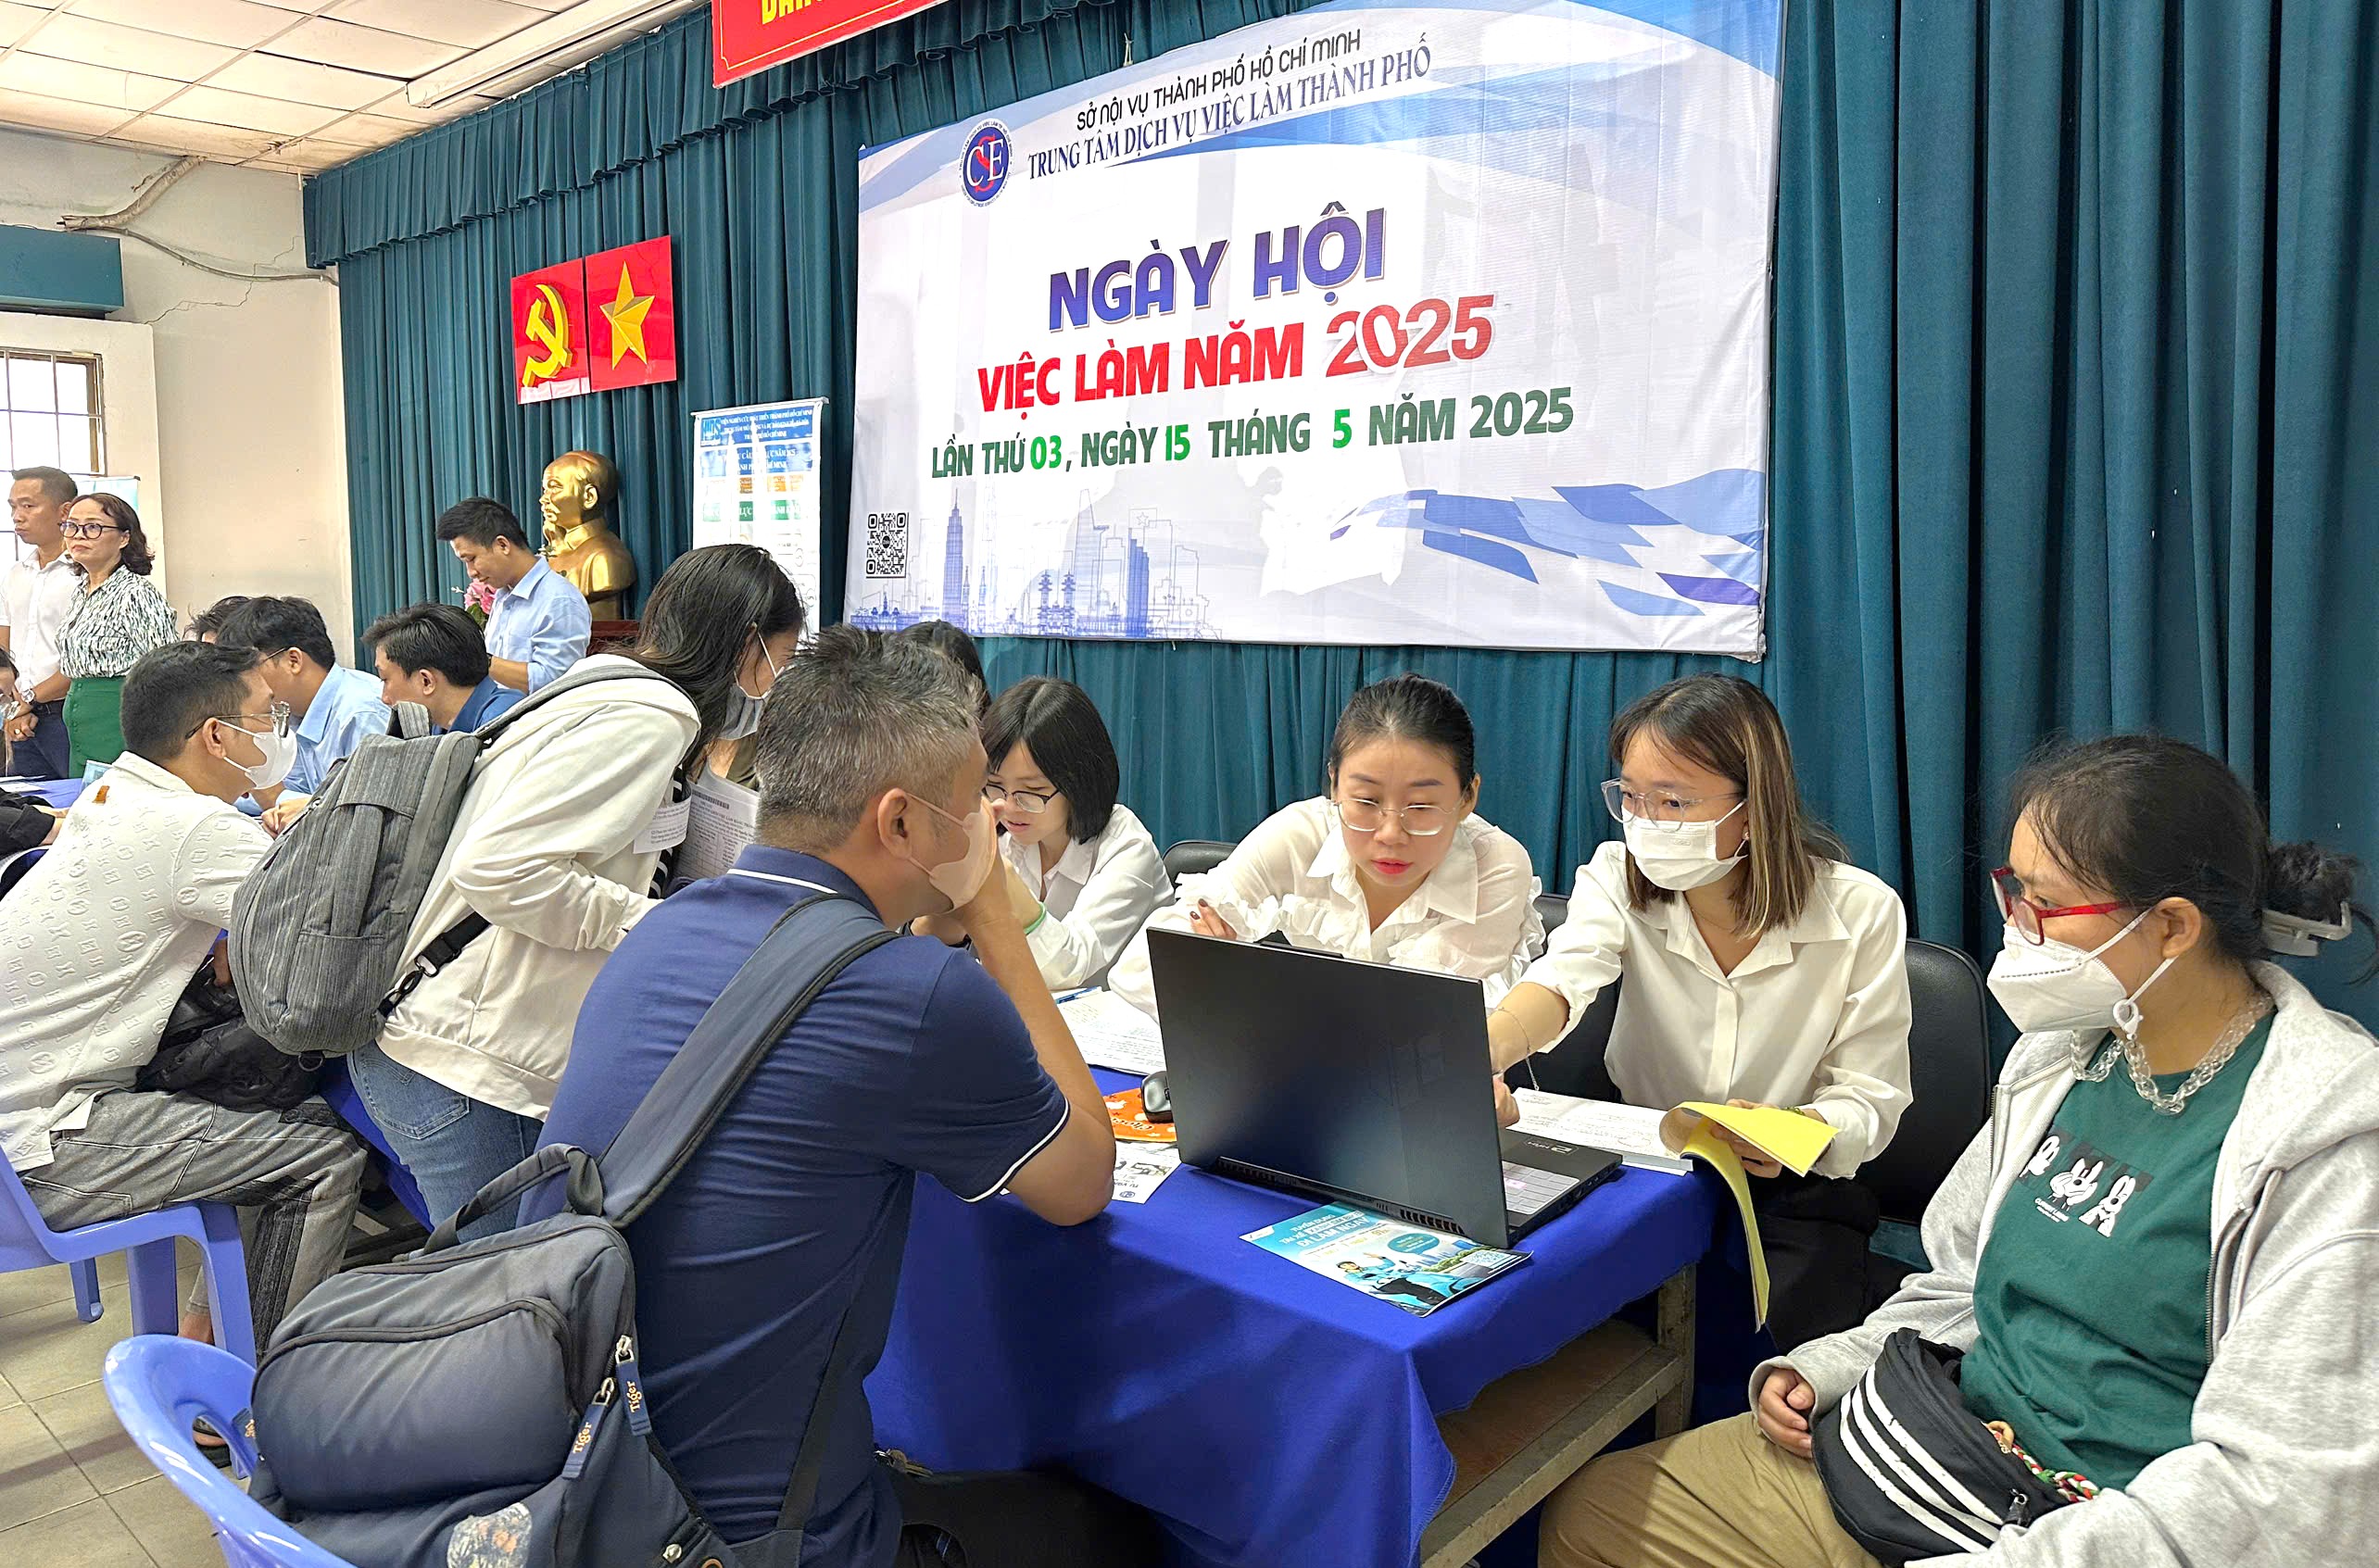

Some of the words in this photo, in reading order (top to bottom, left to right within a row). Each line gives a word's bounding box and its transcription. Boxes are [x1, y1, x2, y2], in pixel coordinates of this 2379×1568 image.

[1027, 142, 1080, 180] TRUNG
[1084, 130, 1120, 165] TÂM
[1125, 117, 1167, 156] DỊCH
[1172, 109, 1197, 143] VỤ
[1202, 93, 1245, 134] VIỆC
[1250, 82, 1292, 121] LÀM
[1297, 59, 1376, 108] THÀNH
[1380, 31, 1431, 87] PHỐ
[1076, 102, 1097, 131] SỞ
[1101, 96, 1122, 125] NỘI
[1127, 93, 1149, 118] VỤ
[1153, 73, 1206, 108] THÀNH
[1212, 53, 1245, 92] PHỐ
[1251, 44, 1273, 81] HỒ
[1279, 37, 1307, 72] CHÍ
[1312, 29, 1361, 63] MINH
[1049, 238, 1229, 333] NGÀY
[1252, 200, 1386, 306] HỘI
[977, 351, 1061, 420] VIỆC
[1075, 339, 1170, 402] LÀM
[1183, 320, 1304, 391] NĂM
[1325, 294, 1496, 379] 2025
[932, 433, 974, 478] LẦN
[981, 432, 1026, 475] THỨ
[1081, 420, 1158, 468] NGÀY
[1164, 423, 1190, 461] 15
[1207, 408, 1311, 458] THÁNG
[1332, 408, 1353, 449] 5
[1368, 392, 1456, 446] NĂM
[1469, 386, 1574, 439] 2025
[573, 1422, 592, 1454] Tiger
[626, 1380, 643, 1413] Tiger
